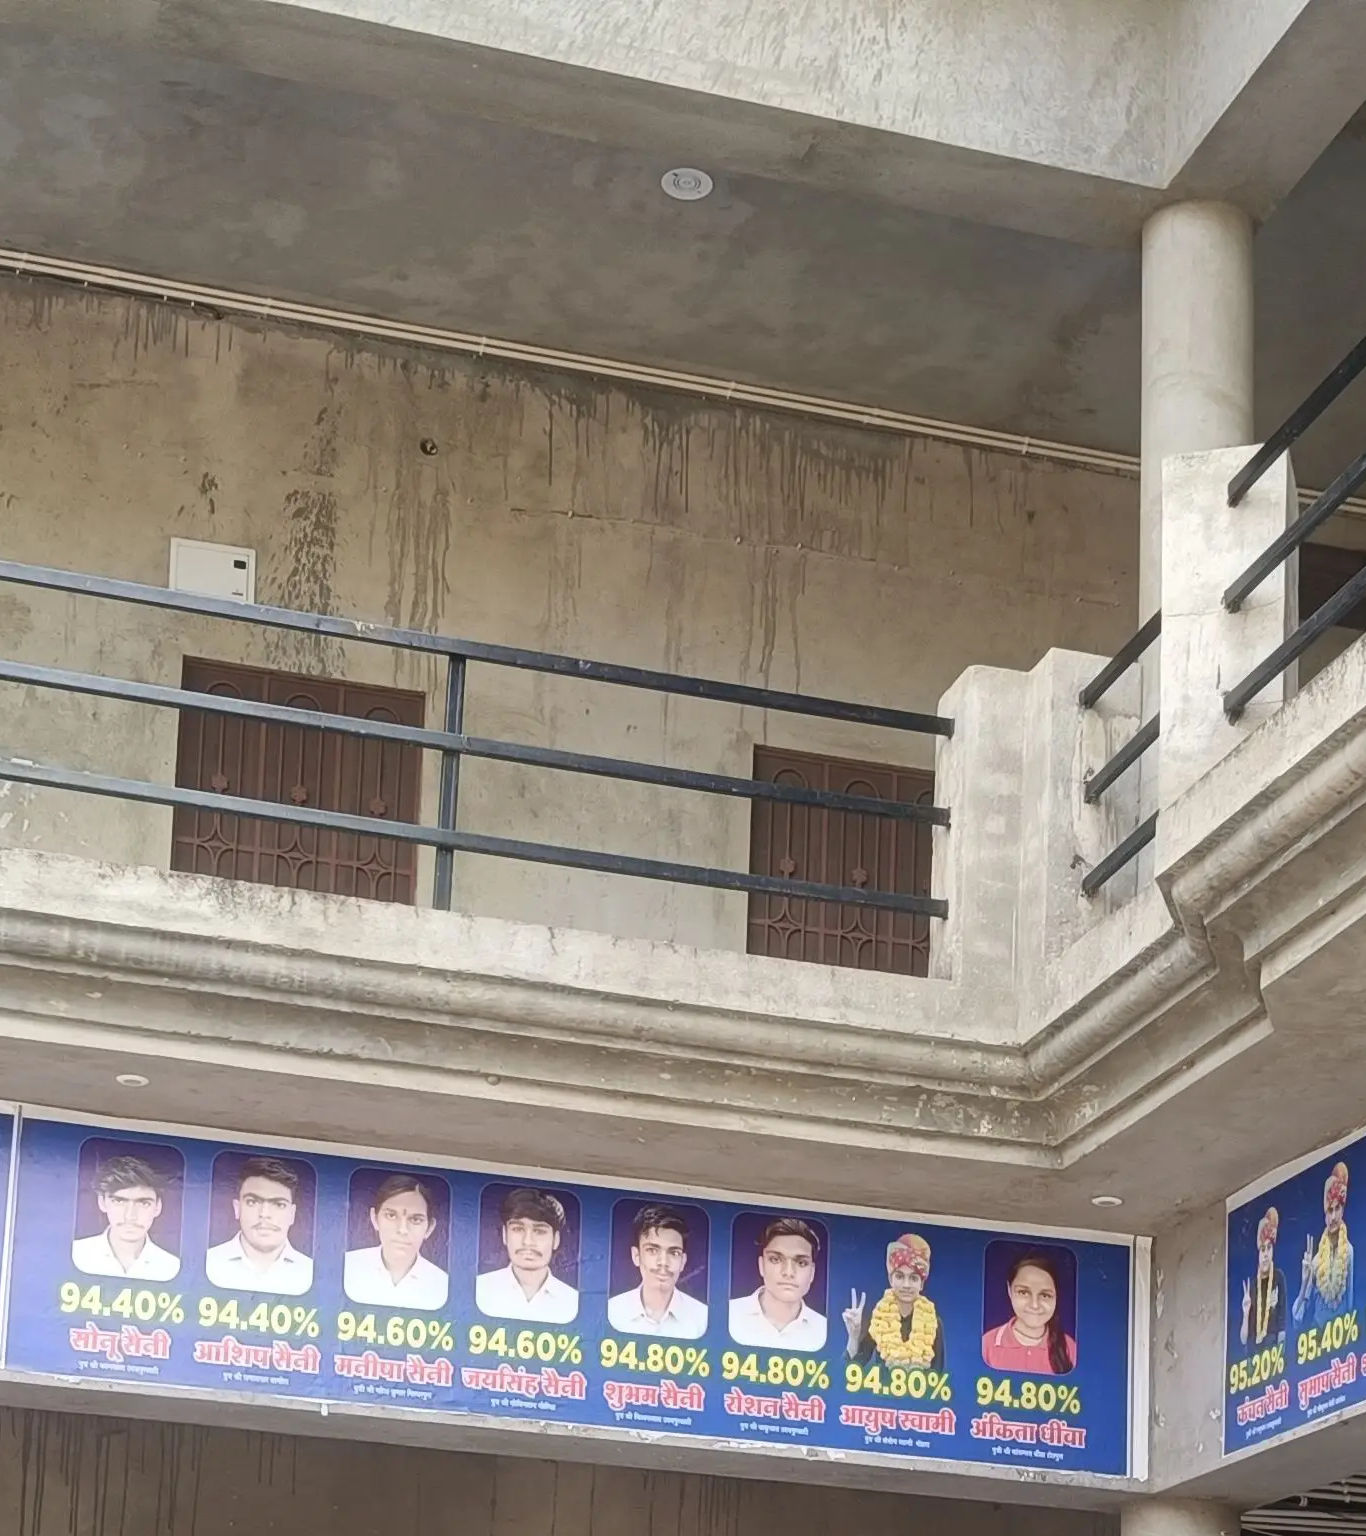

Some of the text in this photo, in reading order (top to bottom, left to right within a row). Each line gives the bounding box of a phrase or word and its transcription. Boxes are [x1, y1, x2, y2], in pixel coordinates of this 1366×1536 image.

[60, 1282, 185, 1324] 94.40%
[198, 1297, 319, 1338] 94.40%
[69, 1322, 171, 1362] सोनू सैनी
[337, 1312, 454, 1351] 94.60%
[468, 1325, 582, 1364] 94.60%
[1297, 1309, 1358, 1365] 95.40%
[271, 1341, 321, 1374] सैनी
[334, 1351, 453, 1388] मनीषा सैनी
[600, 1339, 710, 1378] 94.80%
[721, 1351, 830, 1390] 94.80%
[1230, 1344, 1284, 1394] 95.20%
[1331, 1353, 1356, 1390] सैनी
[461, 1366, 541, 1398] जयसिंह
[540, 1367, 587, 1399] सैनी
[603, 1380, 706, 1411] शुभम सैनी
[845, 1364, 952, 1401] 94.80%
[976, 1377, 1081, 1415] 94.80%
[1262, 1380, 1290, 1418] सैनी
[724, 1388, 826, 1423] रोशन सैनी
[840, 1405, 898, 1435] आयुष
[899, 1408, 956, 1435] स्वामी
[971, 1415, 1039, 1443] अंकिता
